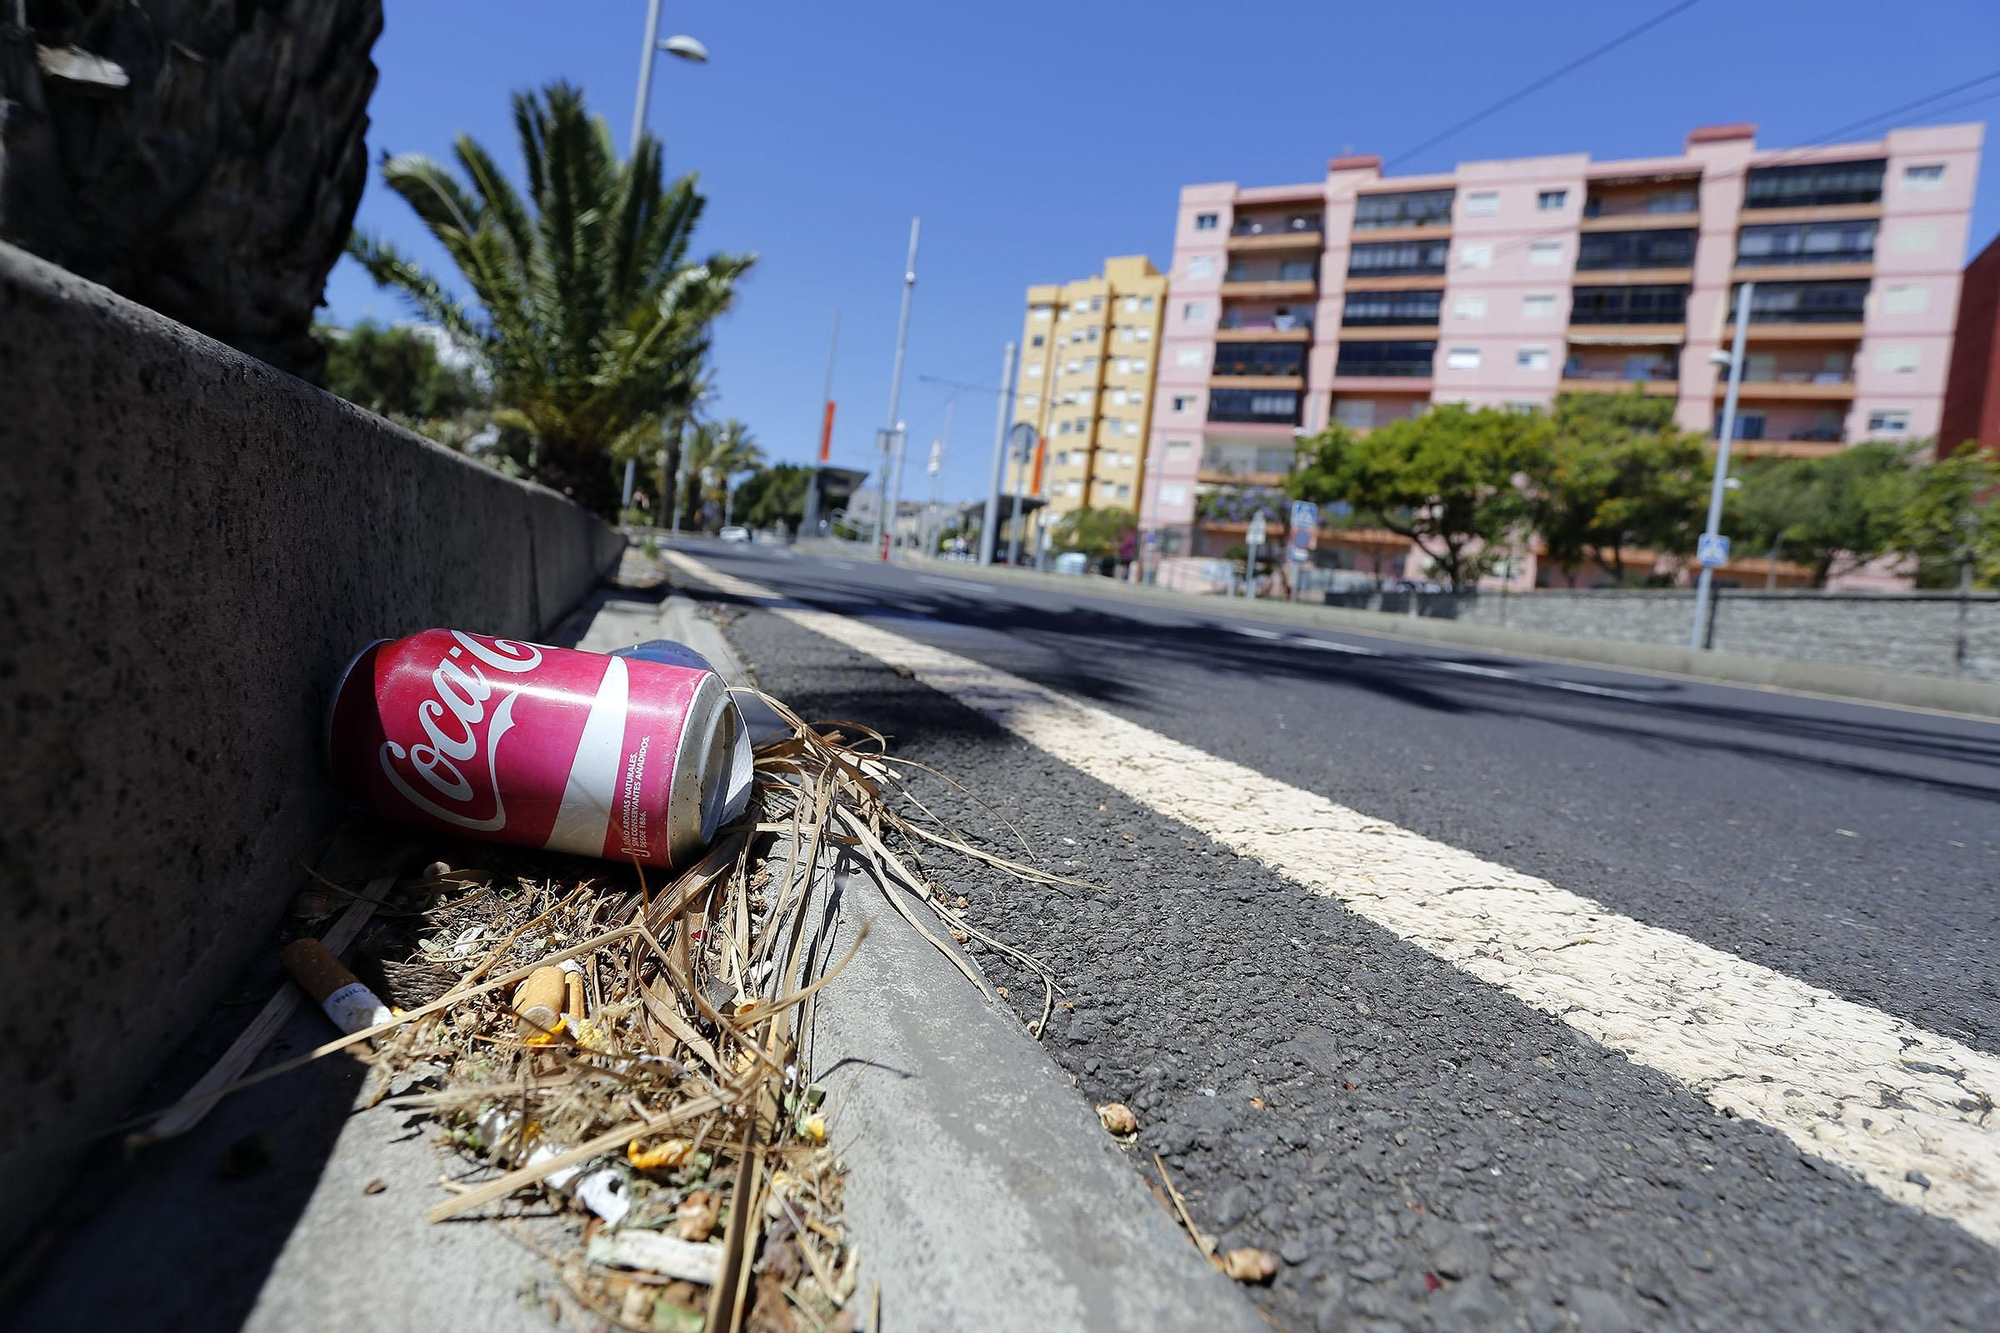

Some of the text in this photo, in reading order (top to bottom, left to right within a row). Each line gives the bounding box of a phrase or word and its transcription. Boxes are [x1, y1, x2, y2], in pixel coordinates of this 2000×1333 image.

[624, 752, 638, 799] NATURALES.
[631, 735, 649, 847] SIN CONSERVANTES AÑADIDOS.
[622, 800, 631, 830] AROMAS
[639, 811, 647, 848] DESDE 1886.
